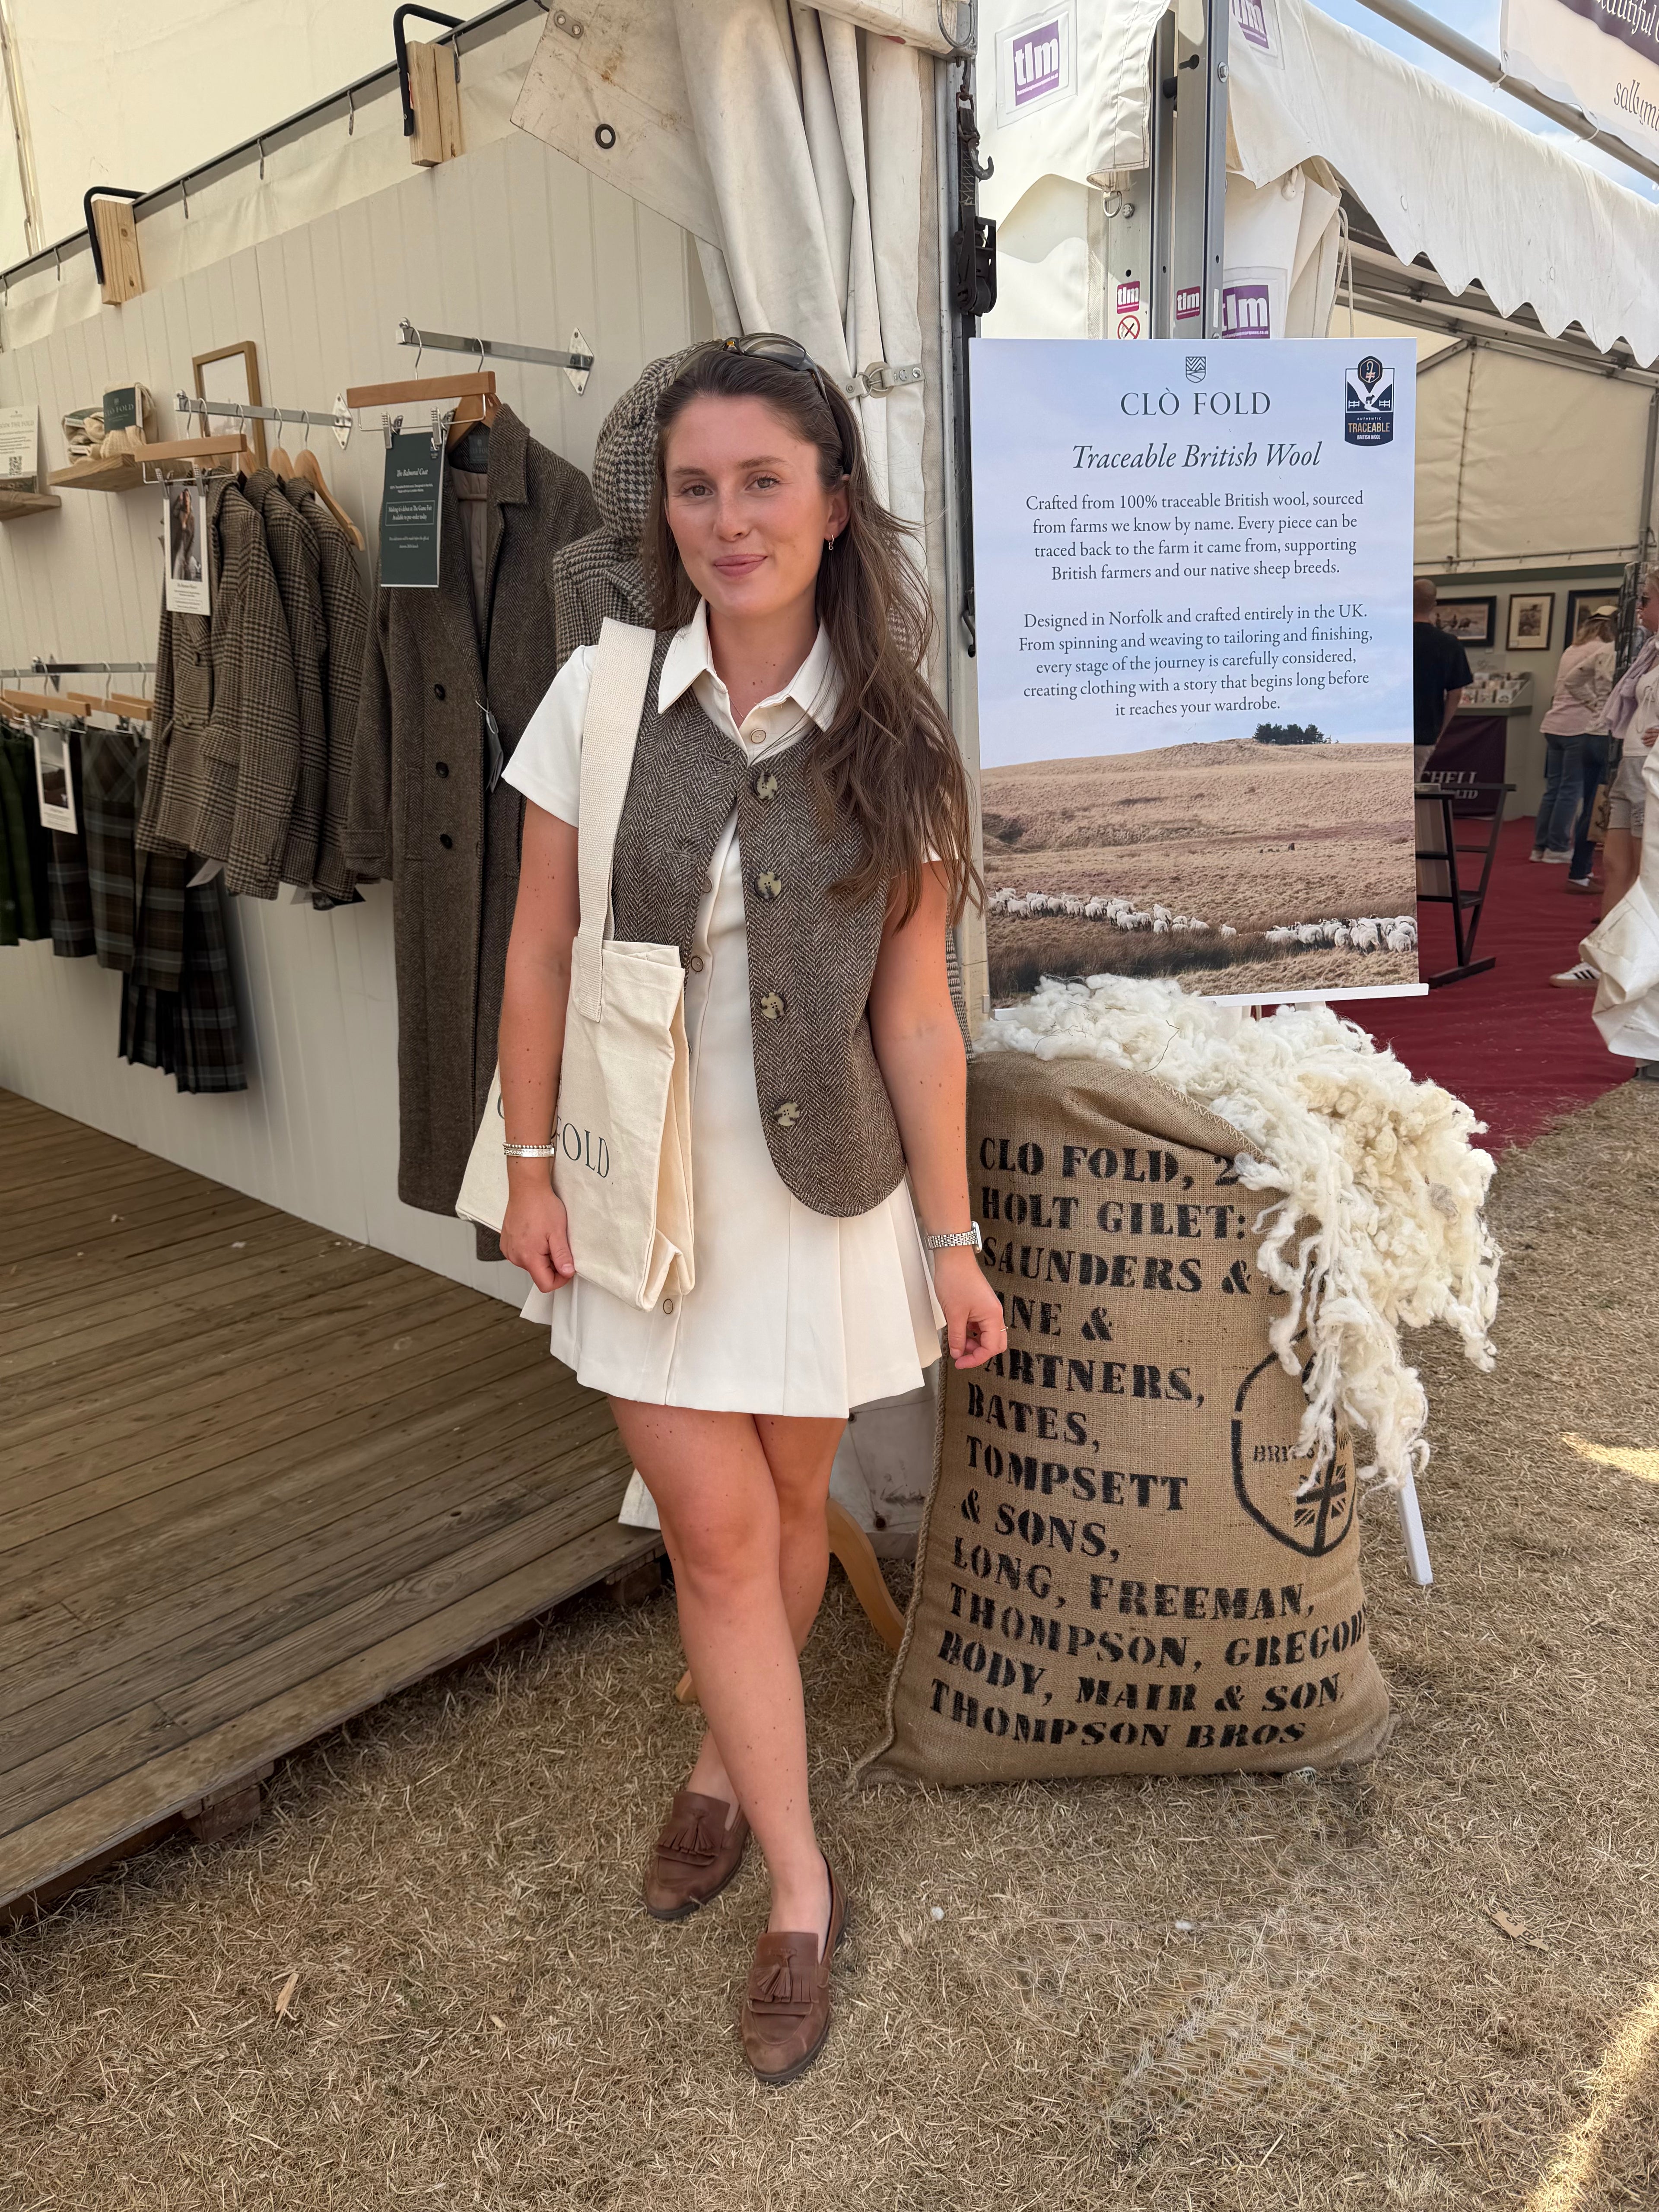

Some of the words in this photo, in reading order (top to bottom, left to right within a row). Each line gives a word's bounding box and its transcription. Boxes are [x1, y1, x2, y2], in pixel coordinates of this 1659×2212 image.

[1014, 38, 1059, 86] tlm
[1118, 286, 1139, 306] tlm
[1177, 292, 1200, 311] tlm
[1121, 387, 1179, 416] CLÒ
[1193, 392, 1270, 415] FOLD
[1348, 422, 1391, 433] TRACEABLE
[1073, 442, 1177, 469] Traceable
[1181, 442, 1258, 467] British
[1266, 441, 1322, 467] Wool
[1026, 494, 1078, 510] Crafted
[1081, 494, 1115, 509] from
[1120, 494, 1157, 509] 100%
[1161, 492, 1221, 508] traceable
[1224, 491, 1269, 507] British
[1272, 491, 1309, 507] wool,
[1313, 489, 1364, 505] sourced
[1033, 518, 1066, 534] from
[1070, 518, 1108, 533] farms
[1110, 523, 1130, 532] we
[1133, 517, 1172, 532] know
[1174, 516, 1191, 536] by
[1194, 521, 1234, 531] name.
[1237, 516, 1275, 534] Every
[1278, 516, 1312, 534] piece
[1316, 519, 1338, 528] can
[1341, 513, 1357, 528] be
[1034, 541, 1077, 557] traced
[1080, 540, 1112, 556] back
[1115, 545, 1129, 555] to
[1133, 540, 1155, 555] the
[1158, 539, 1190, 554] farm
[1193, 540, 1204, 553] it
[1207, 543, 1241, 553] came
[1245, 537, 1281, 553] from,
[1284, 537, 1357, 556] supporting
[1051, 564, 1097, 580] British
[1101, 564, 1151, 579] farmers
[1155, 562, 1180, 578] and
[1183, 567, 1207, 577] our
[1210, 563, 1250, 576] native
[1253, 560, 1290, 579] sheep
[1294, 559, 1340, 574] breeds.
[1023, 611, 1088, 632] Designed
[1092, 612, 1105, 626] in
[1108, 609, 1163, 625] Norfolk
[1166, 607, 1192, 623] and
[1195, 606, 1241, 622] crafted
[1244, 605, 1294, 624] entirely
[1297, 606, 1310, 619] in
[1314, 604, 1335, 619] the
[1338, 604, 1367, 618] UK.
[1018, 637, 1055, 651] From
[1059, 636, 1118, 655] spinning
[1121, 632, 1146, 648] and
[1148, 632, 1203, 650] weaving
[1206, 635, 1220, 645] to
[1224, 629, 1281, 647] tailoring
[1283, 626, 1308, 642] and
[1311, 626, 1373, 644] finishing,
[1036, 664, 1072, 677] every
[1075, 662, 1109, 677] stage
[1112, 655, 1128, 671] of
[1129, 655, 1151, 670] the
[1154, 656, 1206, 674] journey
[1209, 654, 1219, 667] is
[1222, 650, 1279, 669] carefully
[1282, 648, 1356, 664] considered,
[1023, 683, 1077, 700] creating
[1080, 679, 1137, 698] clothing
[1138, 677, 1170, 692] with
[1173, 682, 1181, 691] a
[1183, 680, 1217, 694] story
[1220, 674, 1247, 689] that
[1250, 673, 1293, 692] begins
[1296, 671, 1326, 690] long
[1328, 670, 1369, 685] before
[1115, 703, 1126, 716] it
[1129, 699, 1177, 715] reaches
[1180, 703, 1211, 718] your
[1214, 695, 1280, 712] wardrobe.
[979, 1136, 1045, 1176] CLO
[1062, 1145, 1194, 1190] FOLD,
[981, 1186, 1080, 1231] HOLT
[1097, 1200, 1246, 1240] GILET:
[983, 1236, 1203, 1293] SAUNDERS
[1222, 1259, 1251, 1295] &
[1081, 1306, 1114, 1341] &
[984, 1348, 1205, 1408] ARTNERS,
[967, 1382, 1100, 1452] BATES,
[966, 1435, 1189, 1511] TOMPSETT
[961, 1487, 980, 1525] &
[995, 1503, 1119, 1564] SONS,
[952, 1535, 1067, 1610] LONG,
[1090, 1574, 1315, 1621] FREEMAN,
[950, 1582, 1203, 1674] THOMPSON,
[938, 1629, 1054, 1707] BODY,
[1077, 1676, 1198, 1713] MAIR
[1214, 1685, 1246, 1713] &
[929, 1678, 1172, 1748] THOMPSON
[1186, 1723, 1309, 1748] BROS
